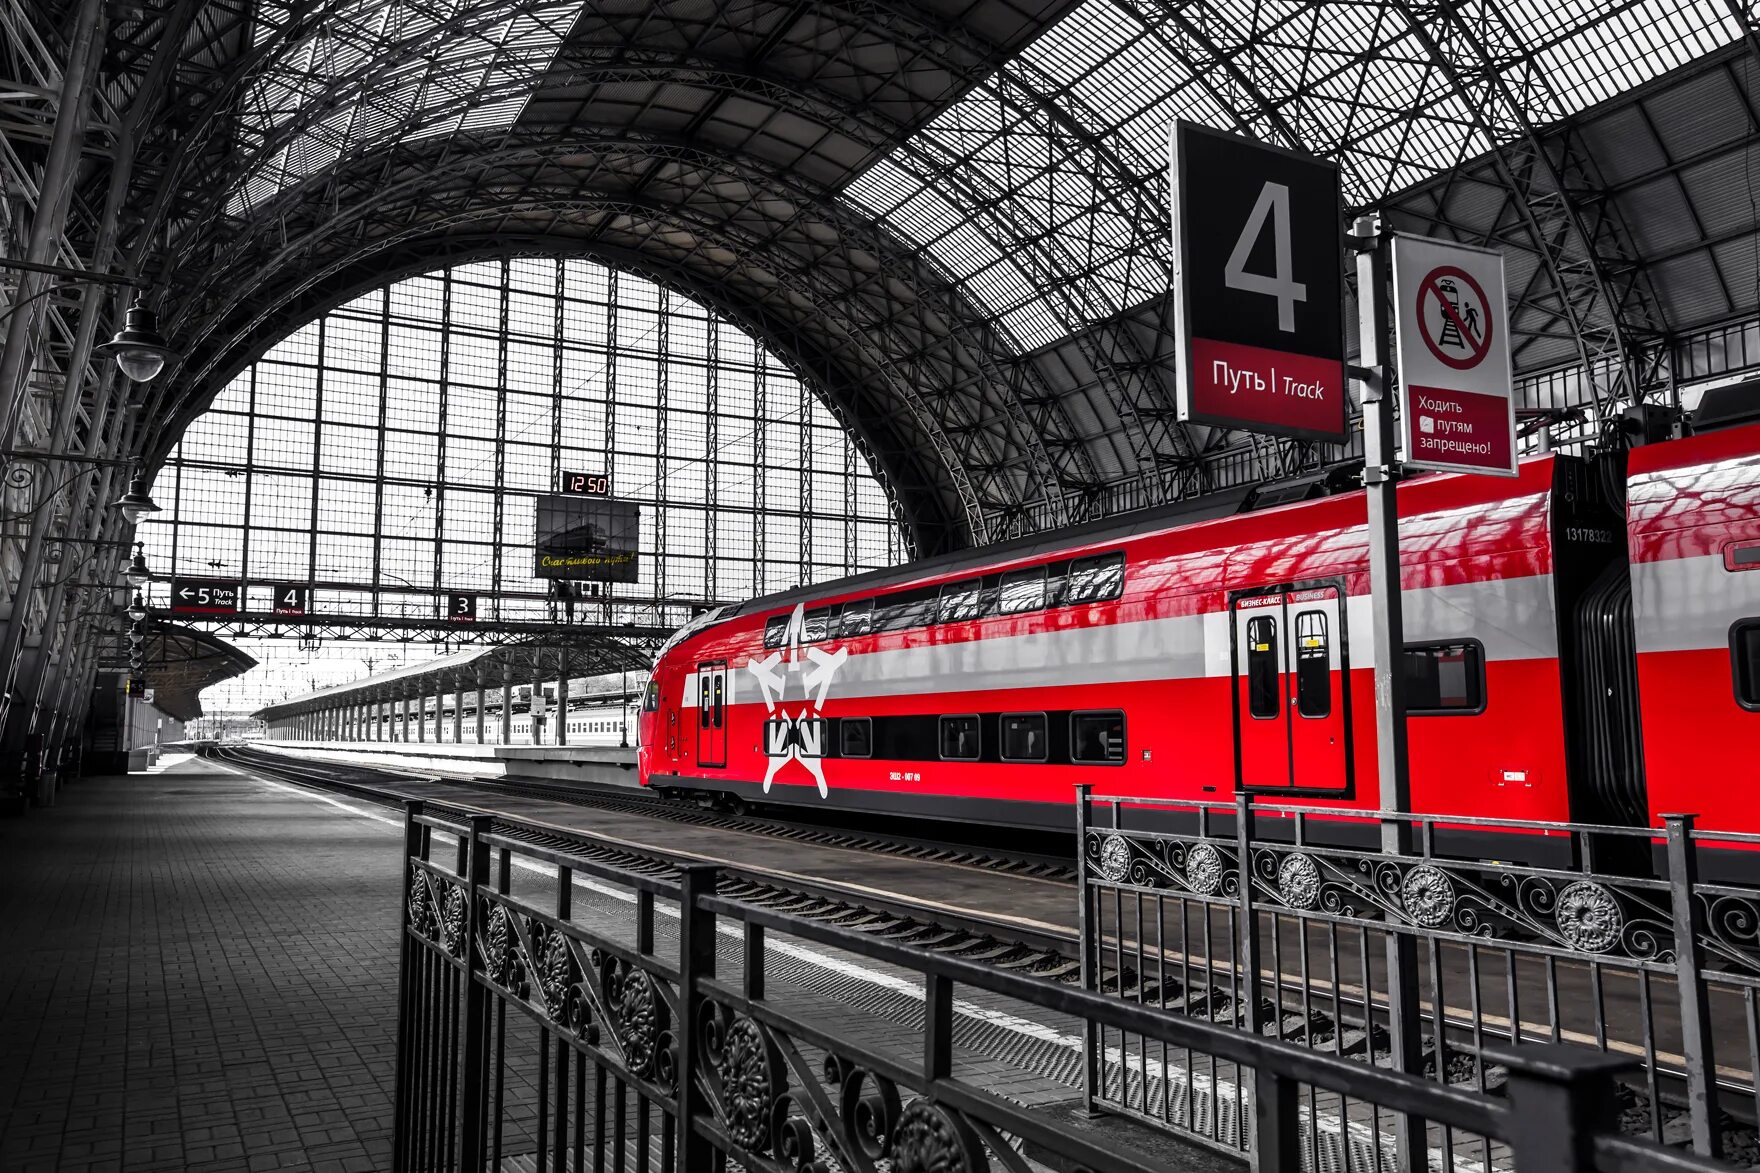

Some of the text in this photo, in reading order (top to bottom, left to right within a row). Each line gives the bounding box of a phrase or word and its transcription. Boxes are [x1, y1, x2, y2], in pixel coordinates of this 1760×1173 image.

[1224, 180, 1308, 333] 4
[1212, 360, 1325, 401] Путь Track
[1418, 395, 1463, 415] Ходить
[1437, 418, 1473, 435] путям
[1420, 436, 1492, 457] запрещено!
[1566, 527, 1613, 544] 13178322
[198, 588, 210, 604] 5
[213, 588, 234, 598] Путь
[283, 589, 298, 607] 4
[1295, 591, 1324, 601] BUSINESS
[457, 597, 469, 614] 3
[1240, 596, 1281, 608] БИЗНЕС-КЛАСС
